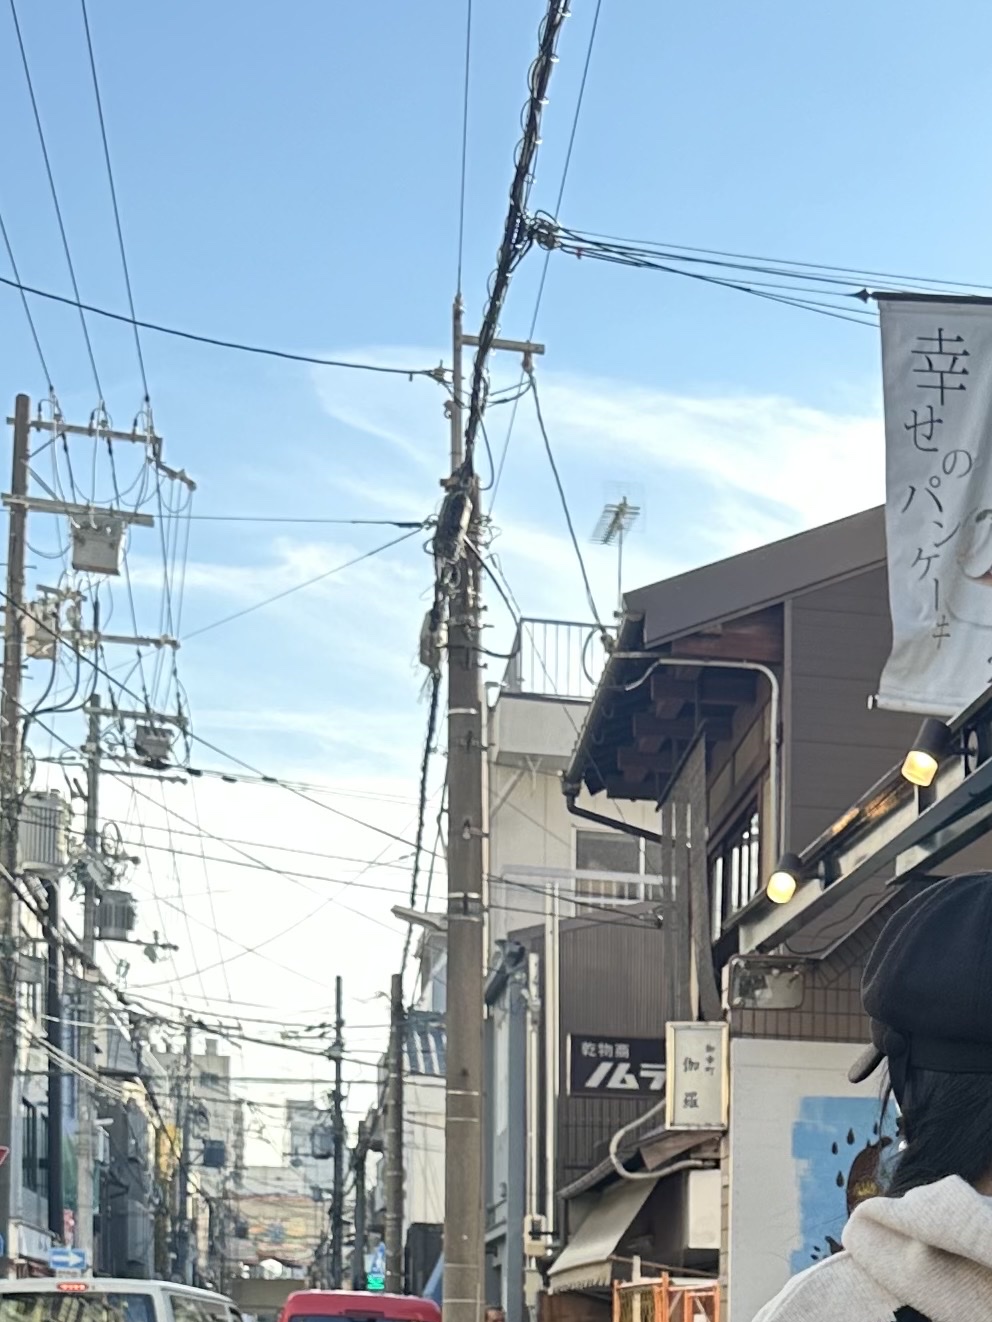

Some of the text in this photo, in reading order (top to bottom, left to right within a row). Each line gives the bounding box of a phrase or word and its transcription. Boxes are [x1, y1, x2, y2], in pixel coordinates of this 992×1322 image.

[903, 327, 973, 651] 幸せのパンケーキ
